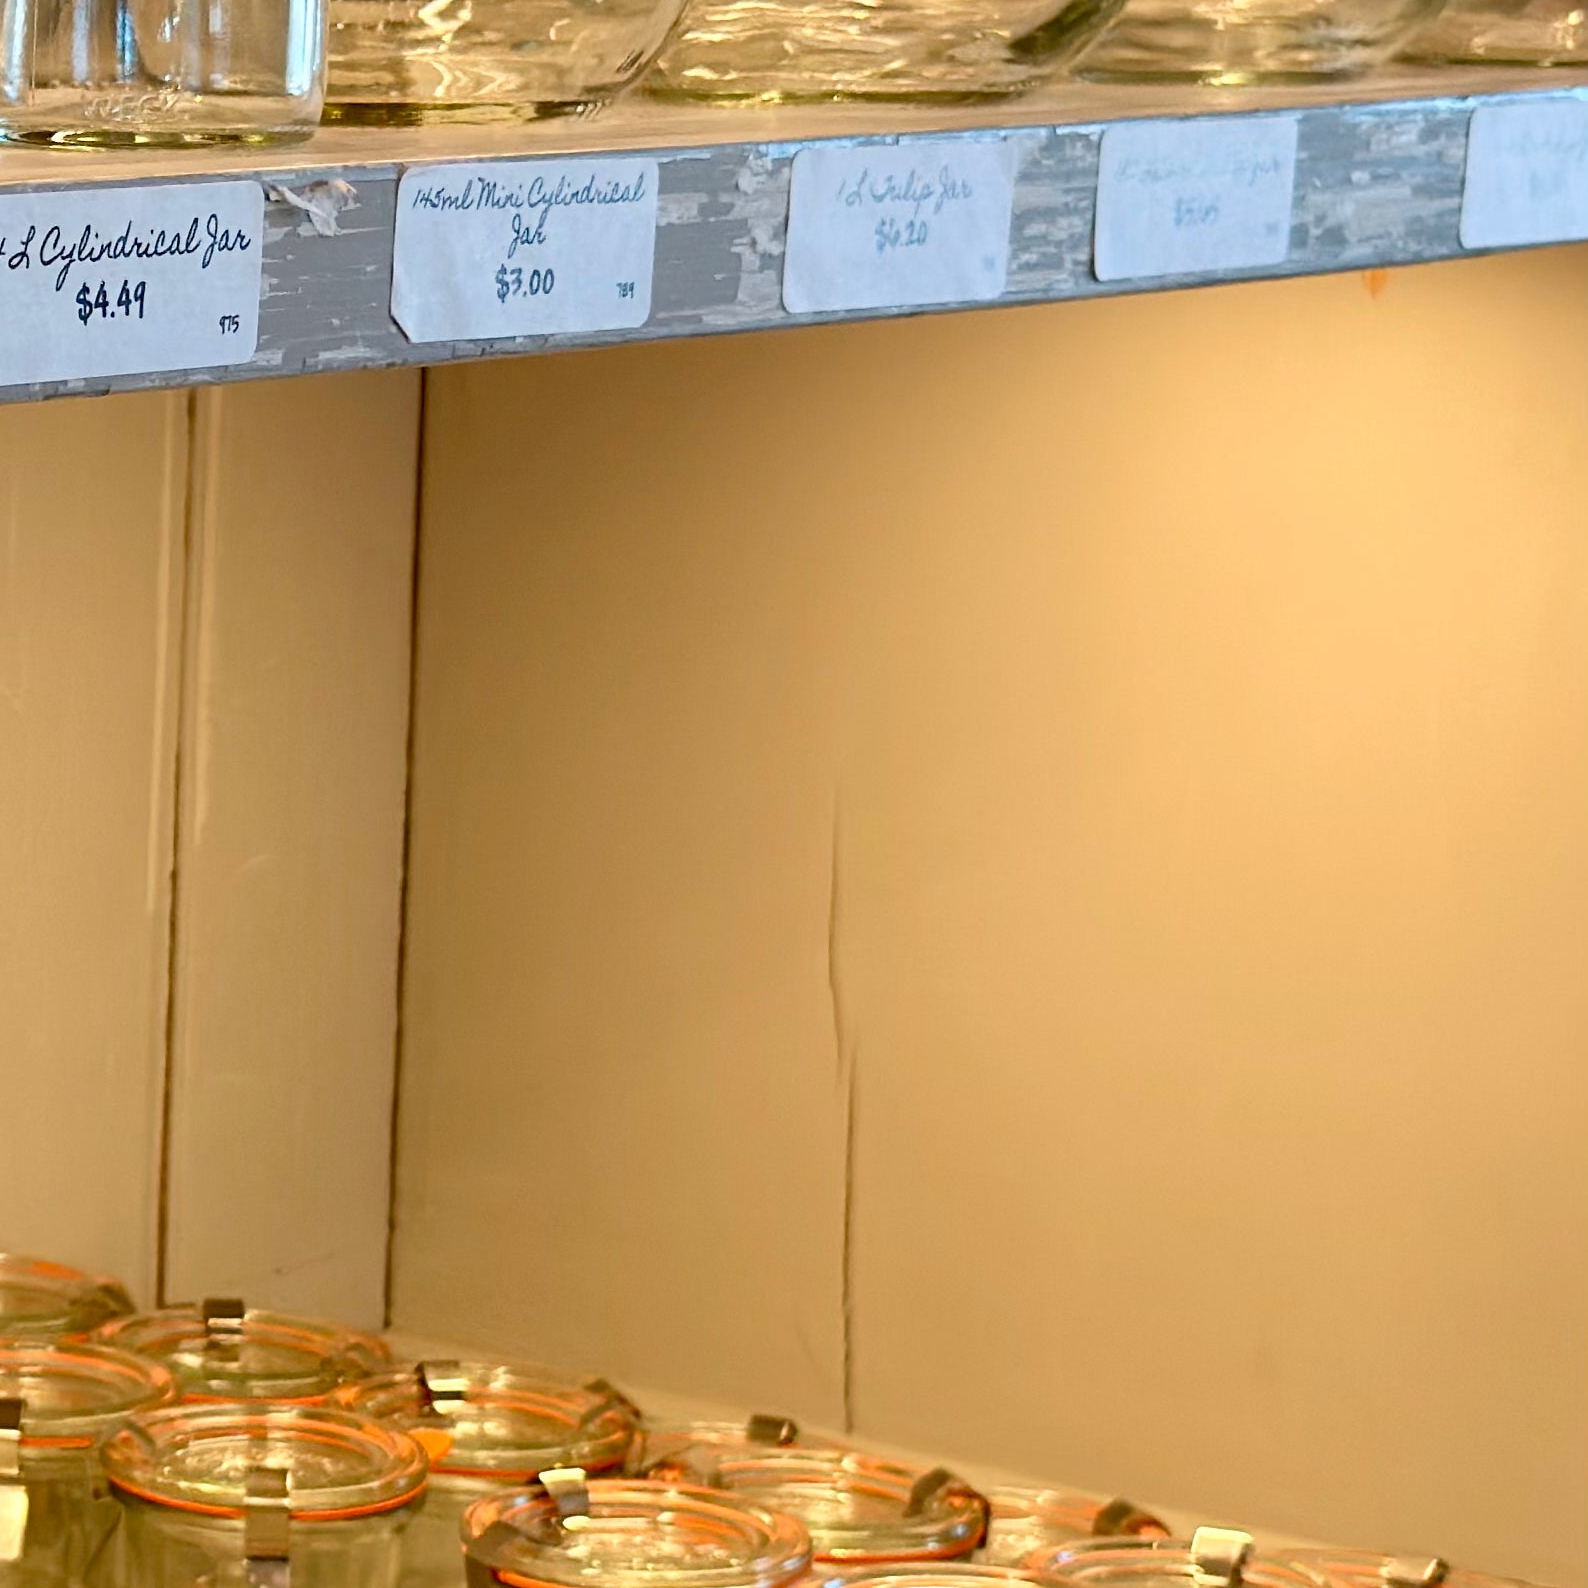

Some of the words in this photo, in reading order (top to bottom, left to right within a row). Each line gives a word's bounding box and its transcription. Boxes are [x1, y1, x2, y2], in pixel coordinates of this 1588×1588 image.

[476, 176, 523, 210] Mini
[527, 171, 647, 224] Cylindrical
[934, 163, 974, 215] Jar
[8, 224, 37, 270] L
[39, 218, 201, 292] Cylindrical
[201, 213, 252, 269] Jar
[506, 213, 547, 260] Jar
[75, 279, 147, 326] $4.49
[494, 263, 555, 304] $3.00
